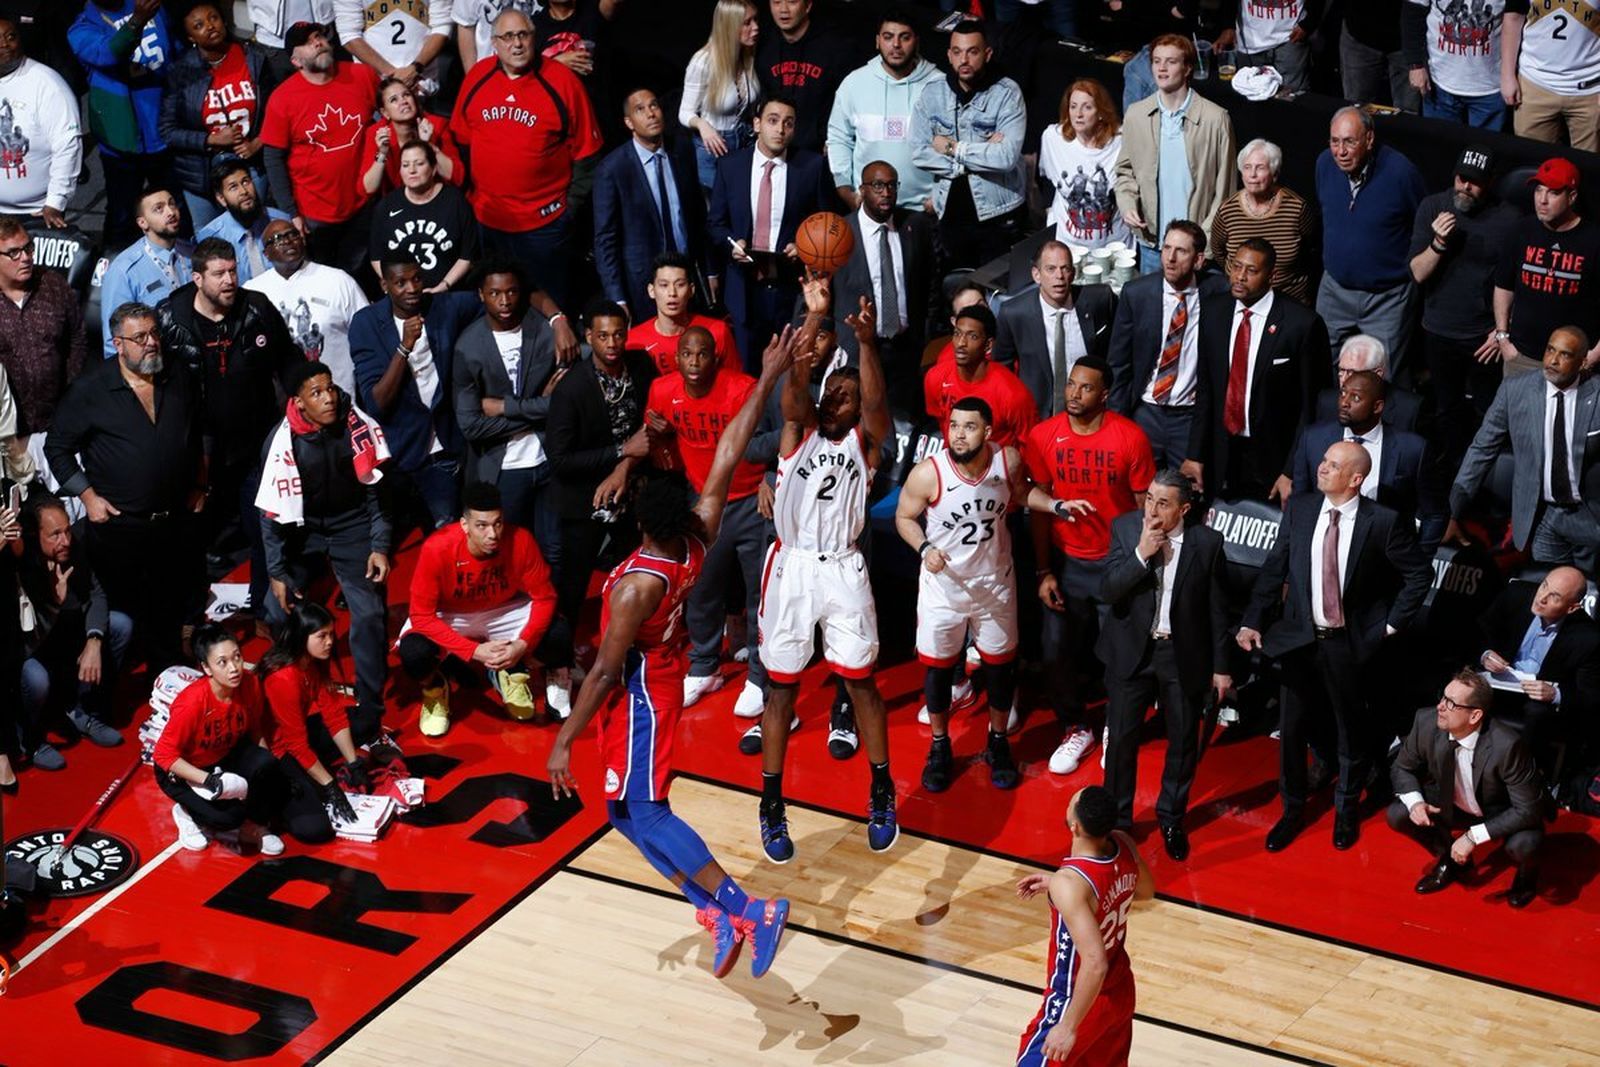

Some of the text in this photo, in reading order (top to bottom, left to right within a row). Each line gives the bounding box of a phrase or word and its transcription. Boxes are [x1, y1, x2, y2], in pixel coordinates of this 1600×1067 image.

[1533, 0, 1593, 22] NOTH
[390, 20, 406, 45] 2
[1552, 15, 1568, 40] 2
[1438, 37, 1491, 56] NORTH
[482, 106, 537, 127] RAPTORS
[388, 219, 453, 251] RAPTORS
[1526, 245, 1584, 272] WE THE
[1522, 271, 1580, 296] NORTH
[672, 410, 729, 429] WE THE
[797, 453, 859, 481] RAPTORS
[1056, 448, 1117, 469] WE THE
[817, 474, 838, 501] 2
[1057, 466, 1117, 487] NORTH
[961, 518, 996, 546] 23
[61, 839, 123, 891] RAPTORS
[1100, 892, 1136, 951] 25
